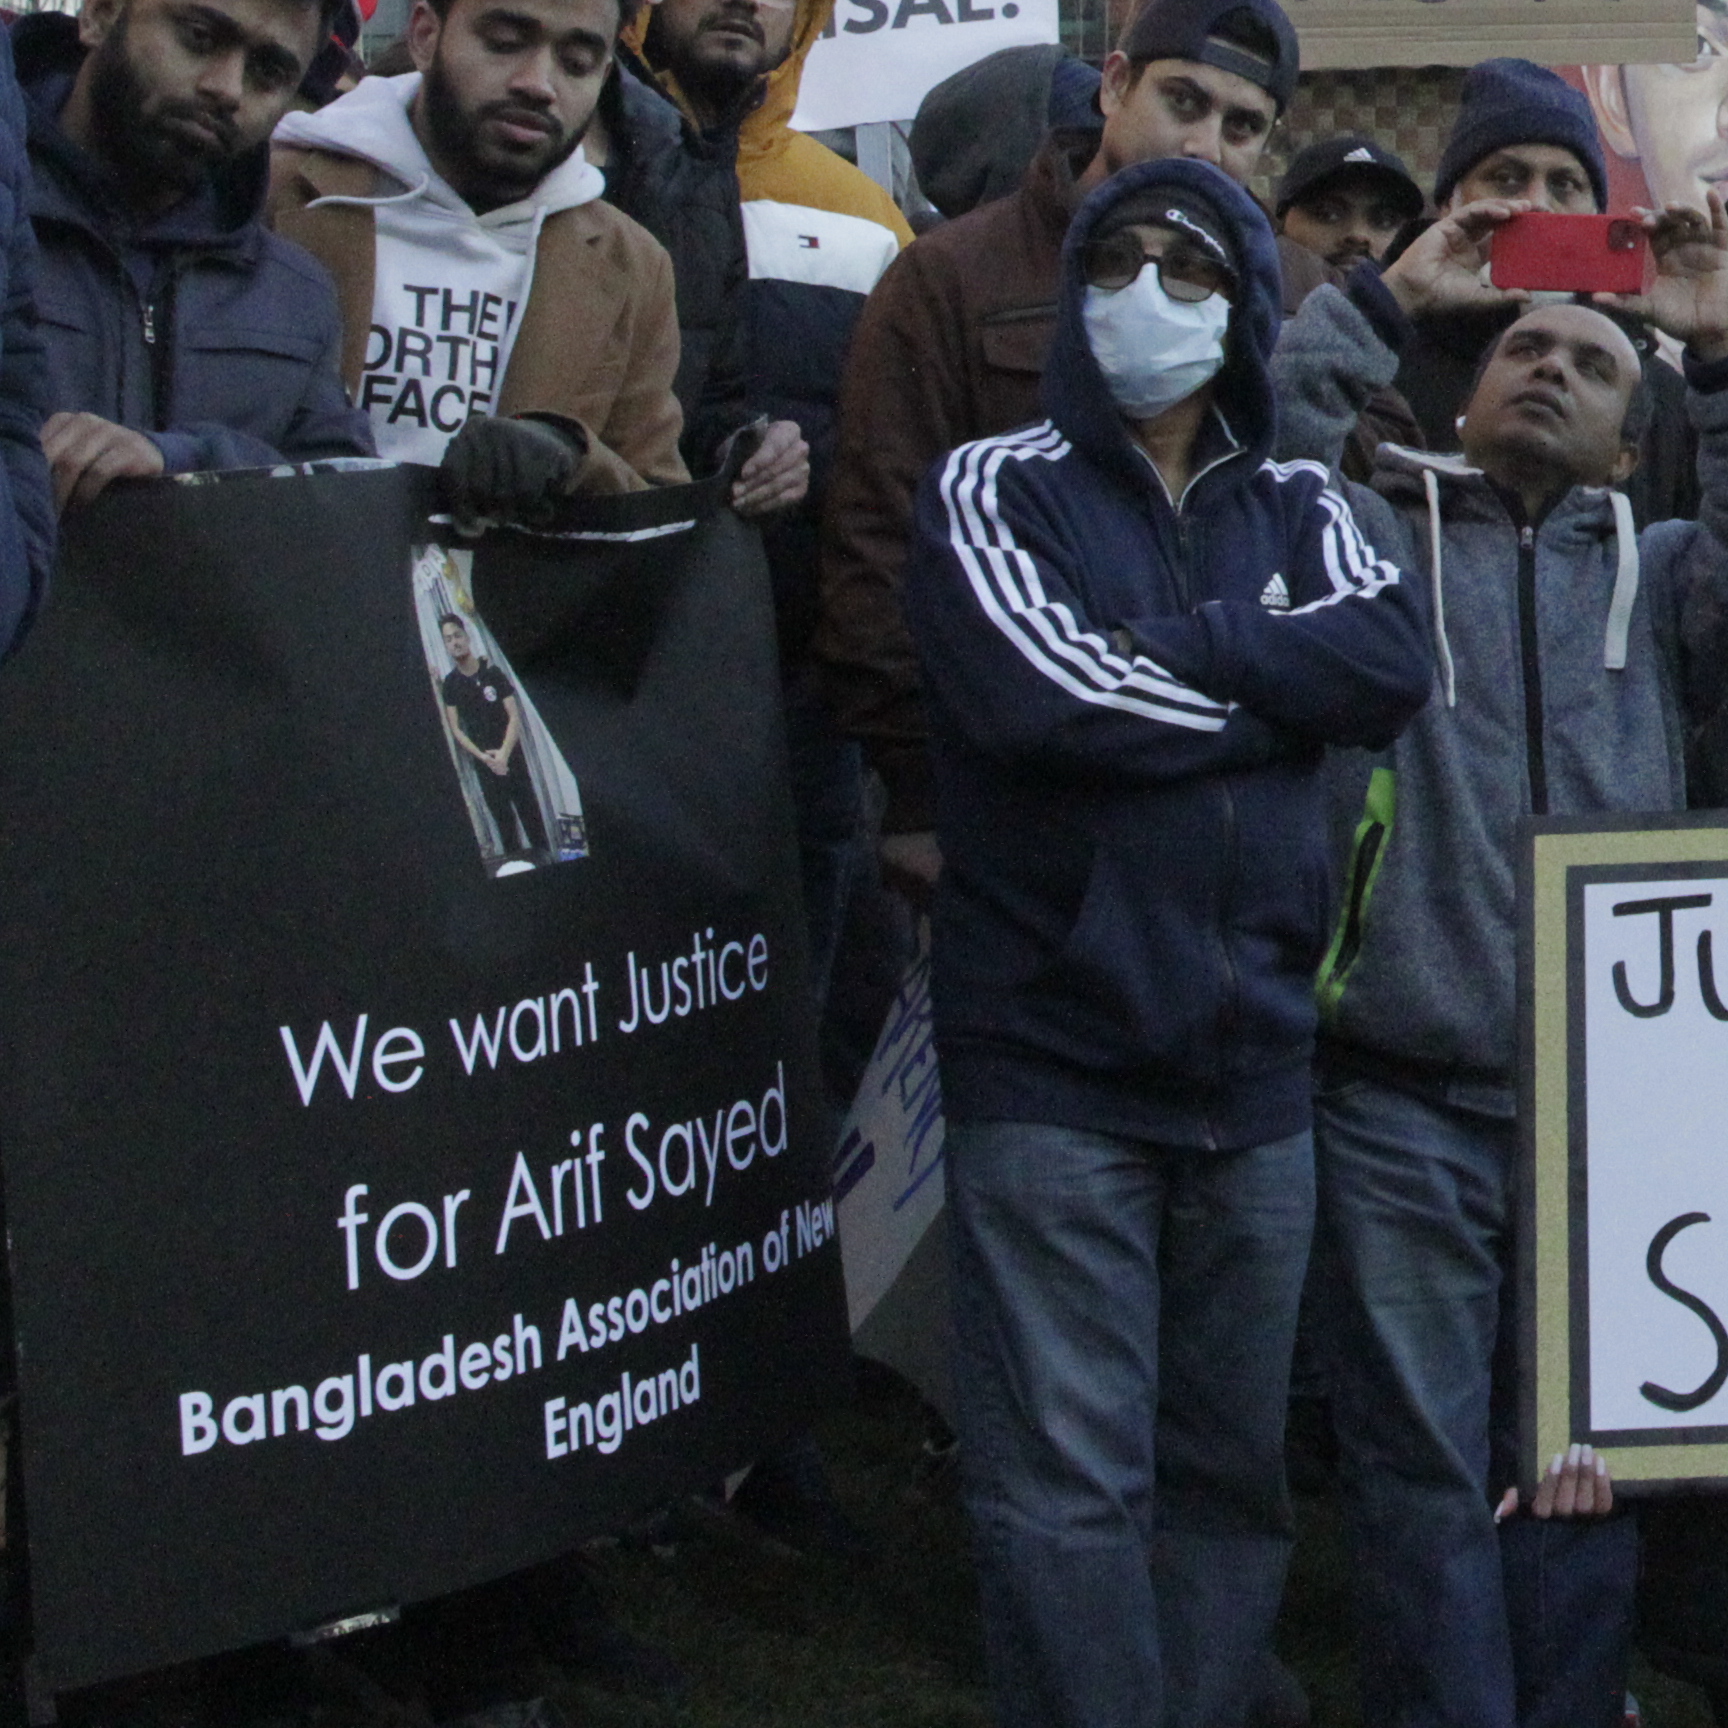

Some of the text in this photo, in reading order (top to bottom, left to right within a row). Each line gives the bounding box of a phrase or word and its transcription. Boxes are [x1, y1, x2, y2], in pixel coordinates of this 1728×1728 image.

[362, 324, 498, 391] ORTH
[403, 284, 502, 342] THE
[280, 926, 768, 1107] We want Justice
[337, 1185, 470, 1291] for
[496, 1118, 605, 1256] Arif
[626, 1062, 787, 1214] Sayed
[179, 1195, 835, 1456] Bangladesh Association of New
[545, 1343, 700, 1459] England
